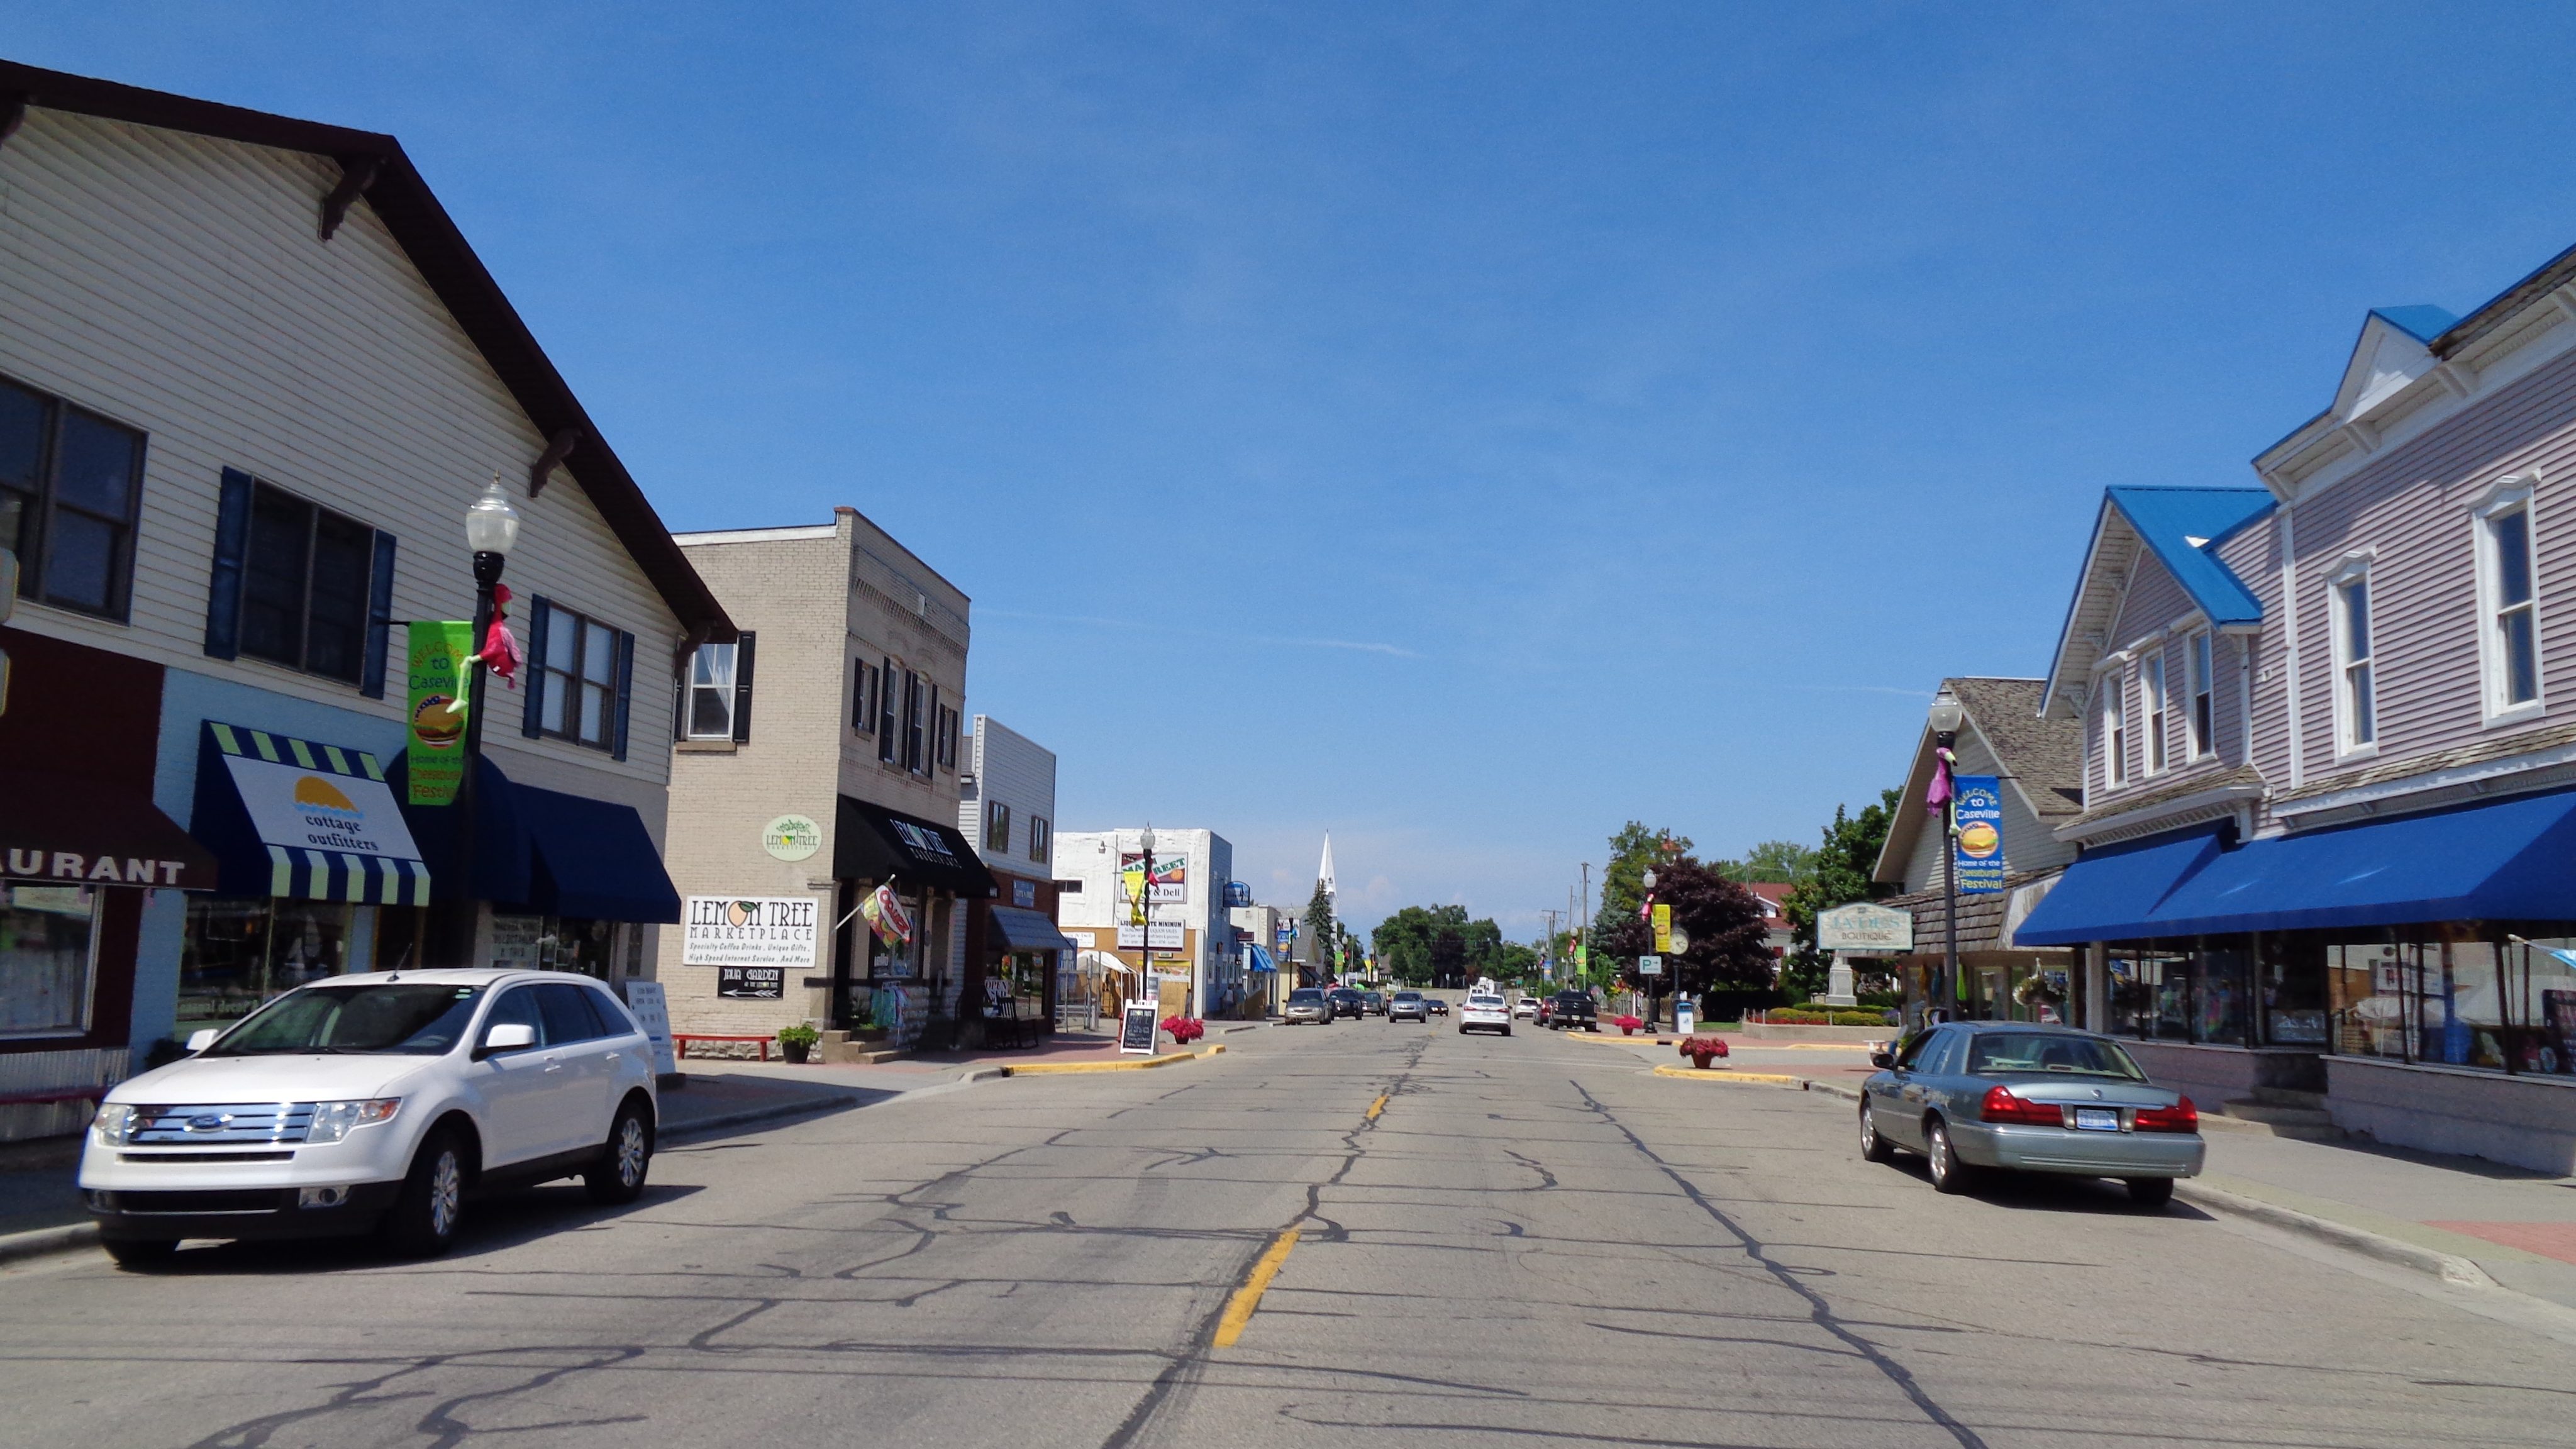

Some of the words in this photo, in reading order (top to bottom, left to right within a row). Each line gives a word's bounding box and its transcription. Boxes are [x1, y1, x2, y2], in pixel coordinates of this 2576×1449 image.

[412, 641, 464, 670] WELCOM
[432, 658, 449, 670] to
[1957, 787, 1997, 806] WELCOME
[1970, 798, 1984, 807] to
[1956, 809, 2000, 819] Caseville
[306, 816, 361, 835] cottage
[308, 833, 379, 851] outfitters
[767, 835, 796, 846] LEMON
[799, 835, 818, 846] TREE
[0, 848, 185, 884] URANT
[1960, 878, 2002, 889] Festival
[691, 901, 762, 928] LEMON
[769, 902, 813, 927] TREE
[690, 927, 812, 940] MARKETPLACE
[689, 942, 718, 952] Specialty
[688, 953, 702, 963] High
[705, 954, 723, 963] Speed
[1643, 959, 1652, 970] P
[746, 969, 779, 981] GARDEN
